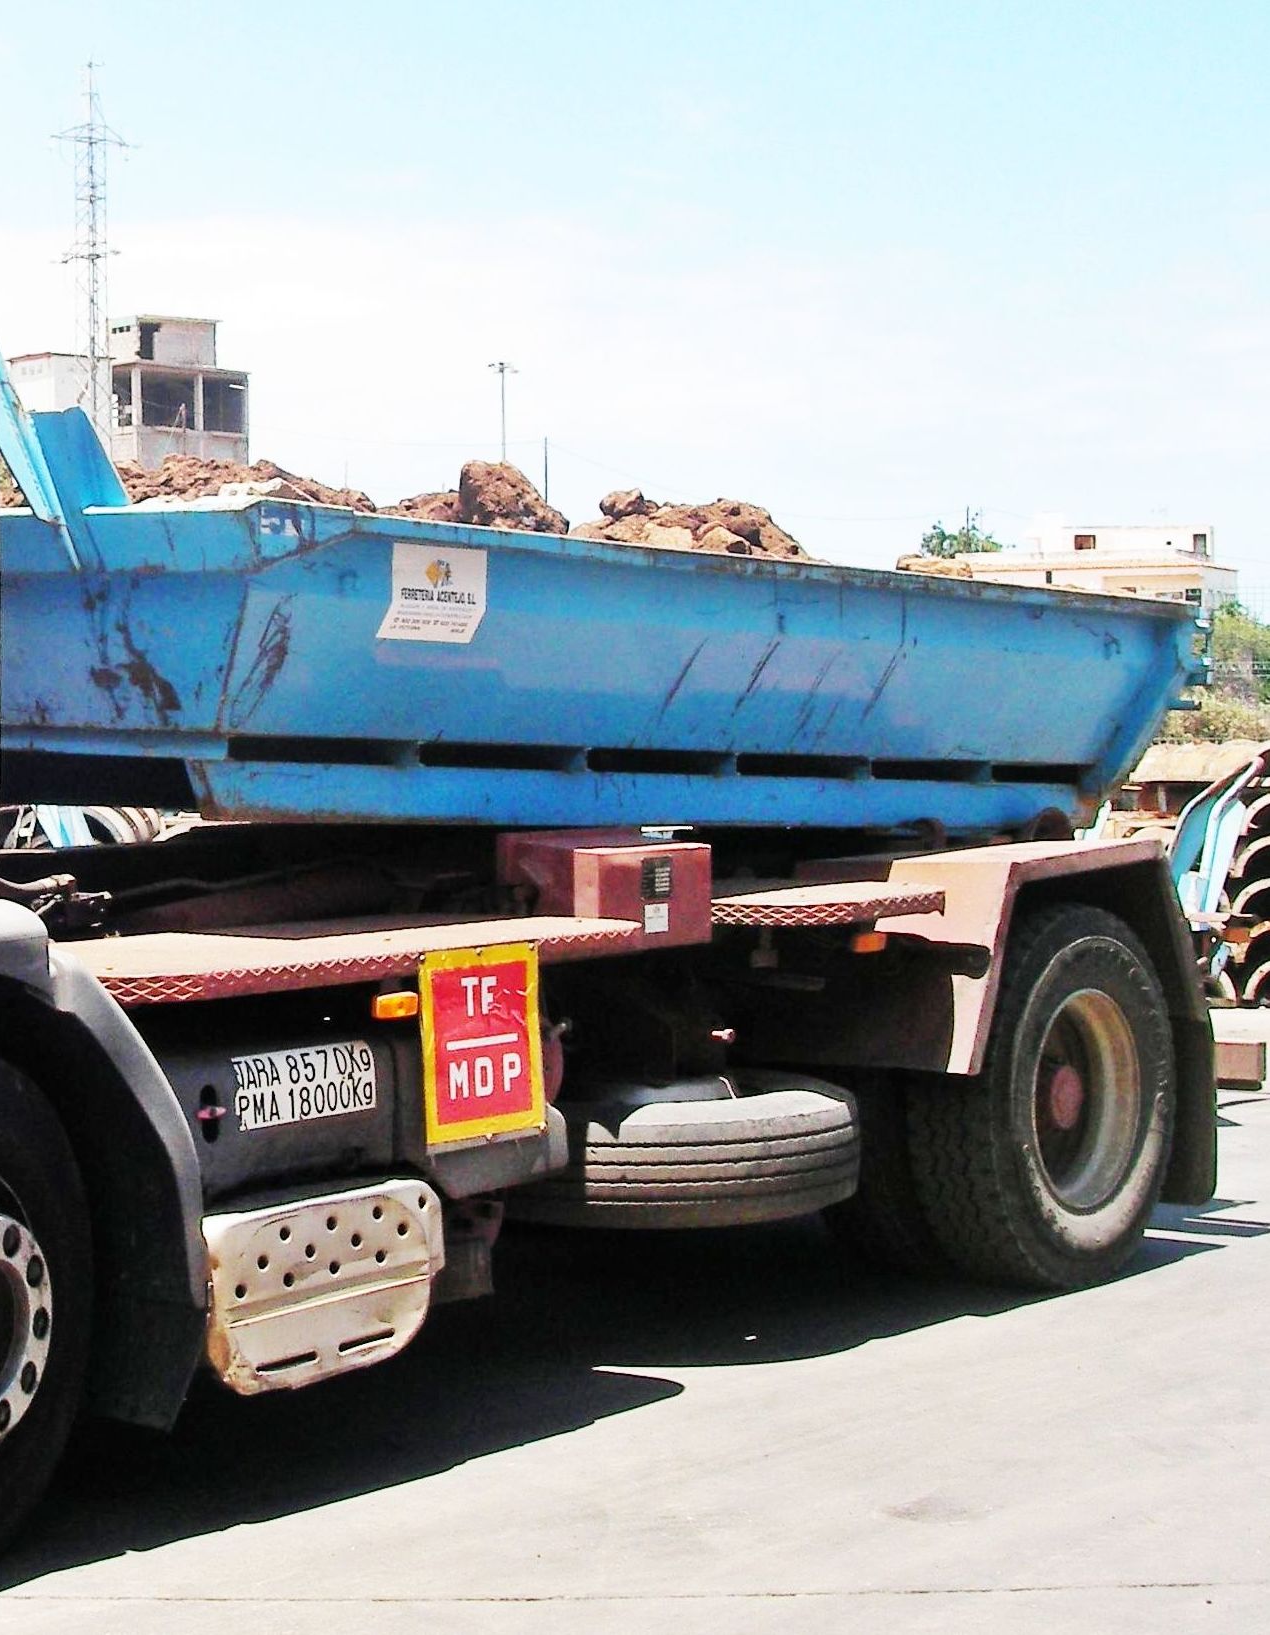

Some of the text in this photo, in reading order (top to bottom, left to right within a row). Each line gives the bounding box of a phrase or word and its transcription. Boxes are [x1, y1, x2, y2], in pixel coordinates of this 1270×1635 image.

[460, 975, 498, 1017] TF
[231, 1056, 282, 1091] TARA
[237, 1089, 281, 1126] PMA
